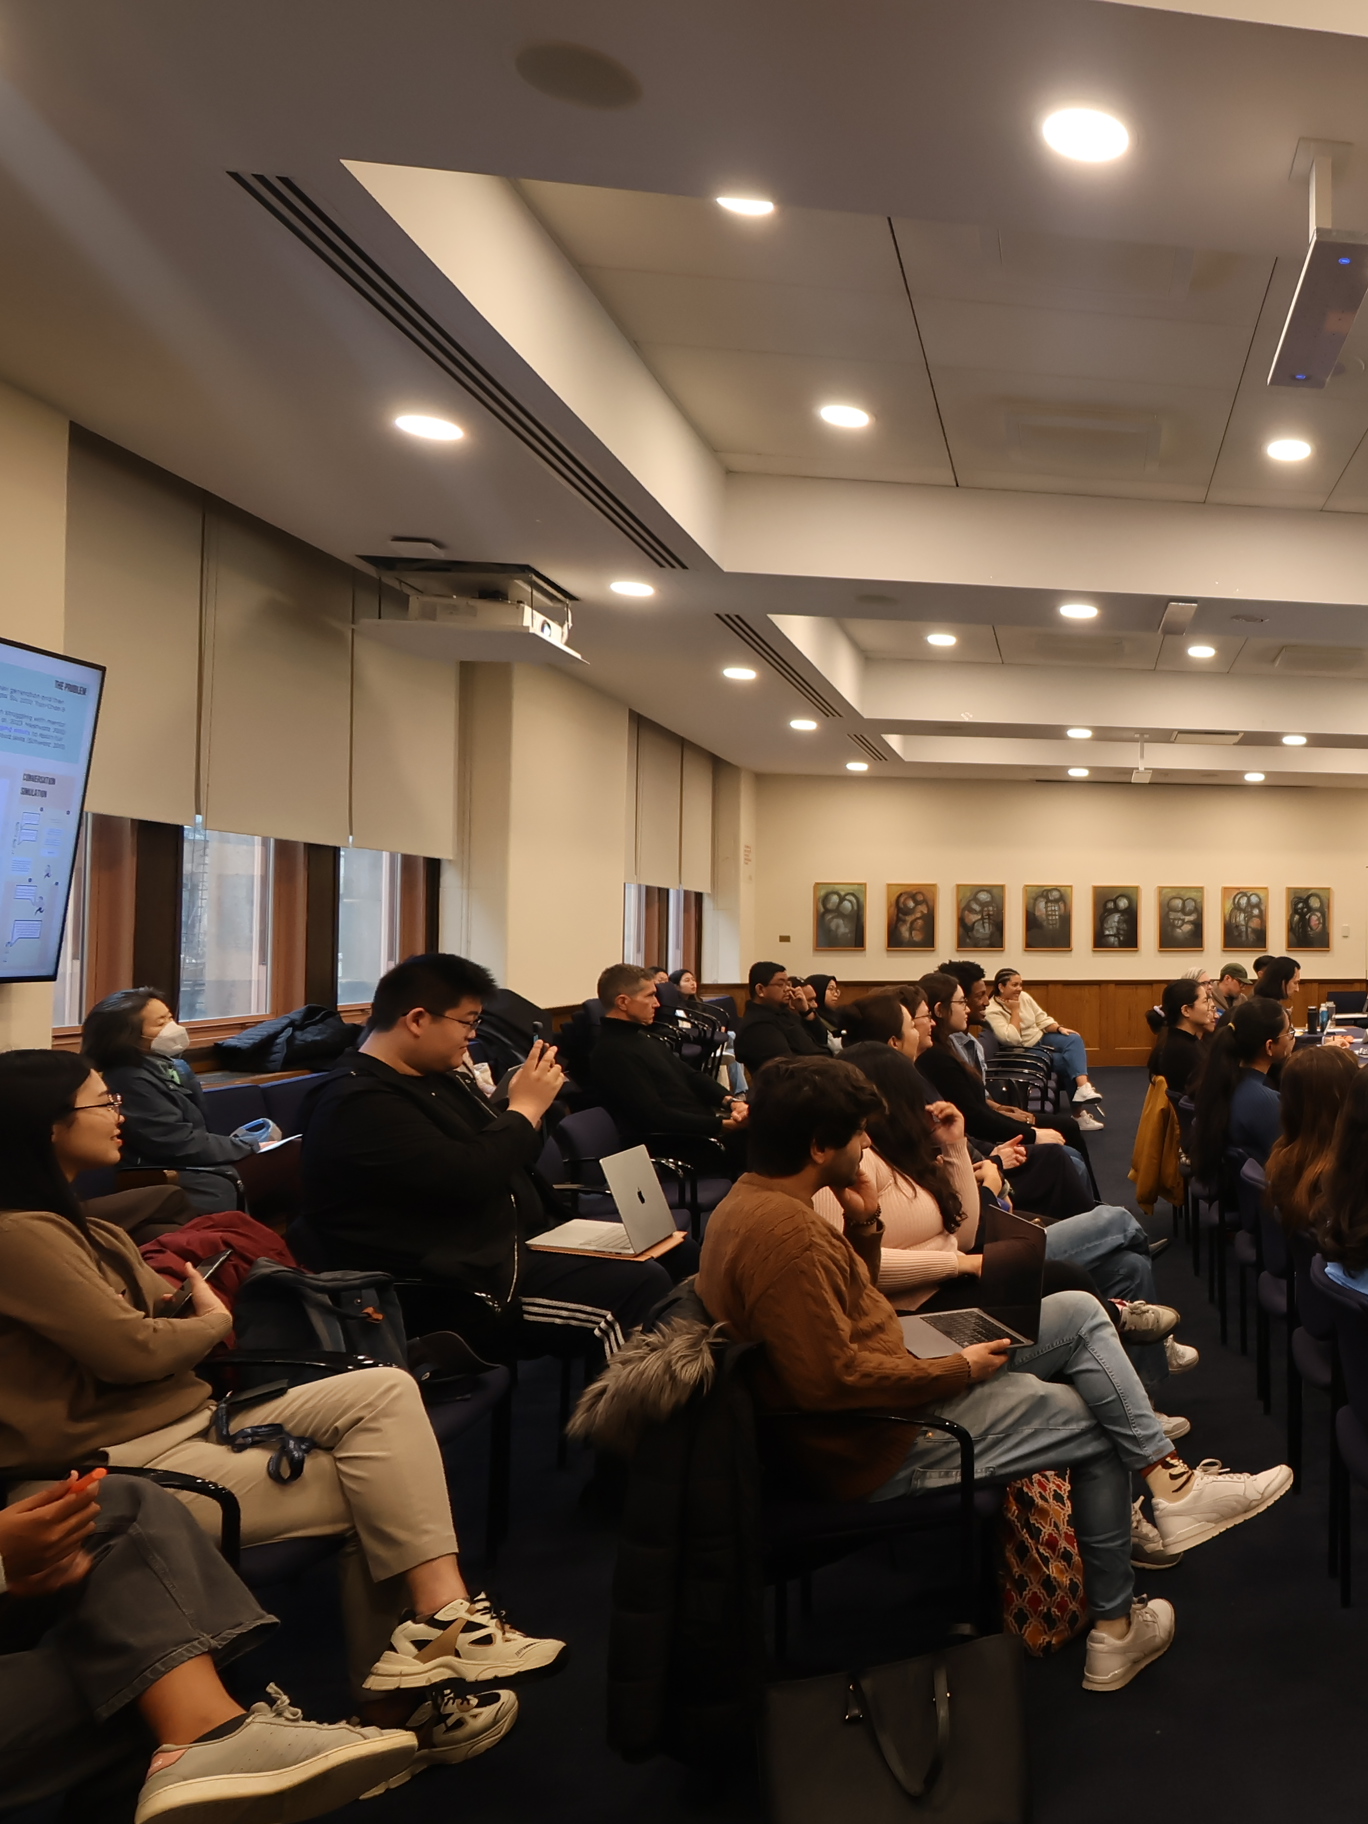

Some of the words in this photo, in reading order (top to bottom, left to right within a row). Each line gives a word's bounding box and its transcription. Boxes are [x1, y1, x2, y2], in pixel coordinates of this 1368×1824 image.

[55, 680, 64, 691] THE
[64, 683, 87, 696] PROBLEM
[22, 773, 56, 786] CONVERSATION
[20, 787, 48, 798] SIMULATION
